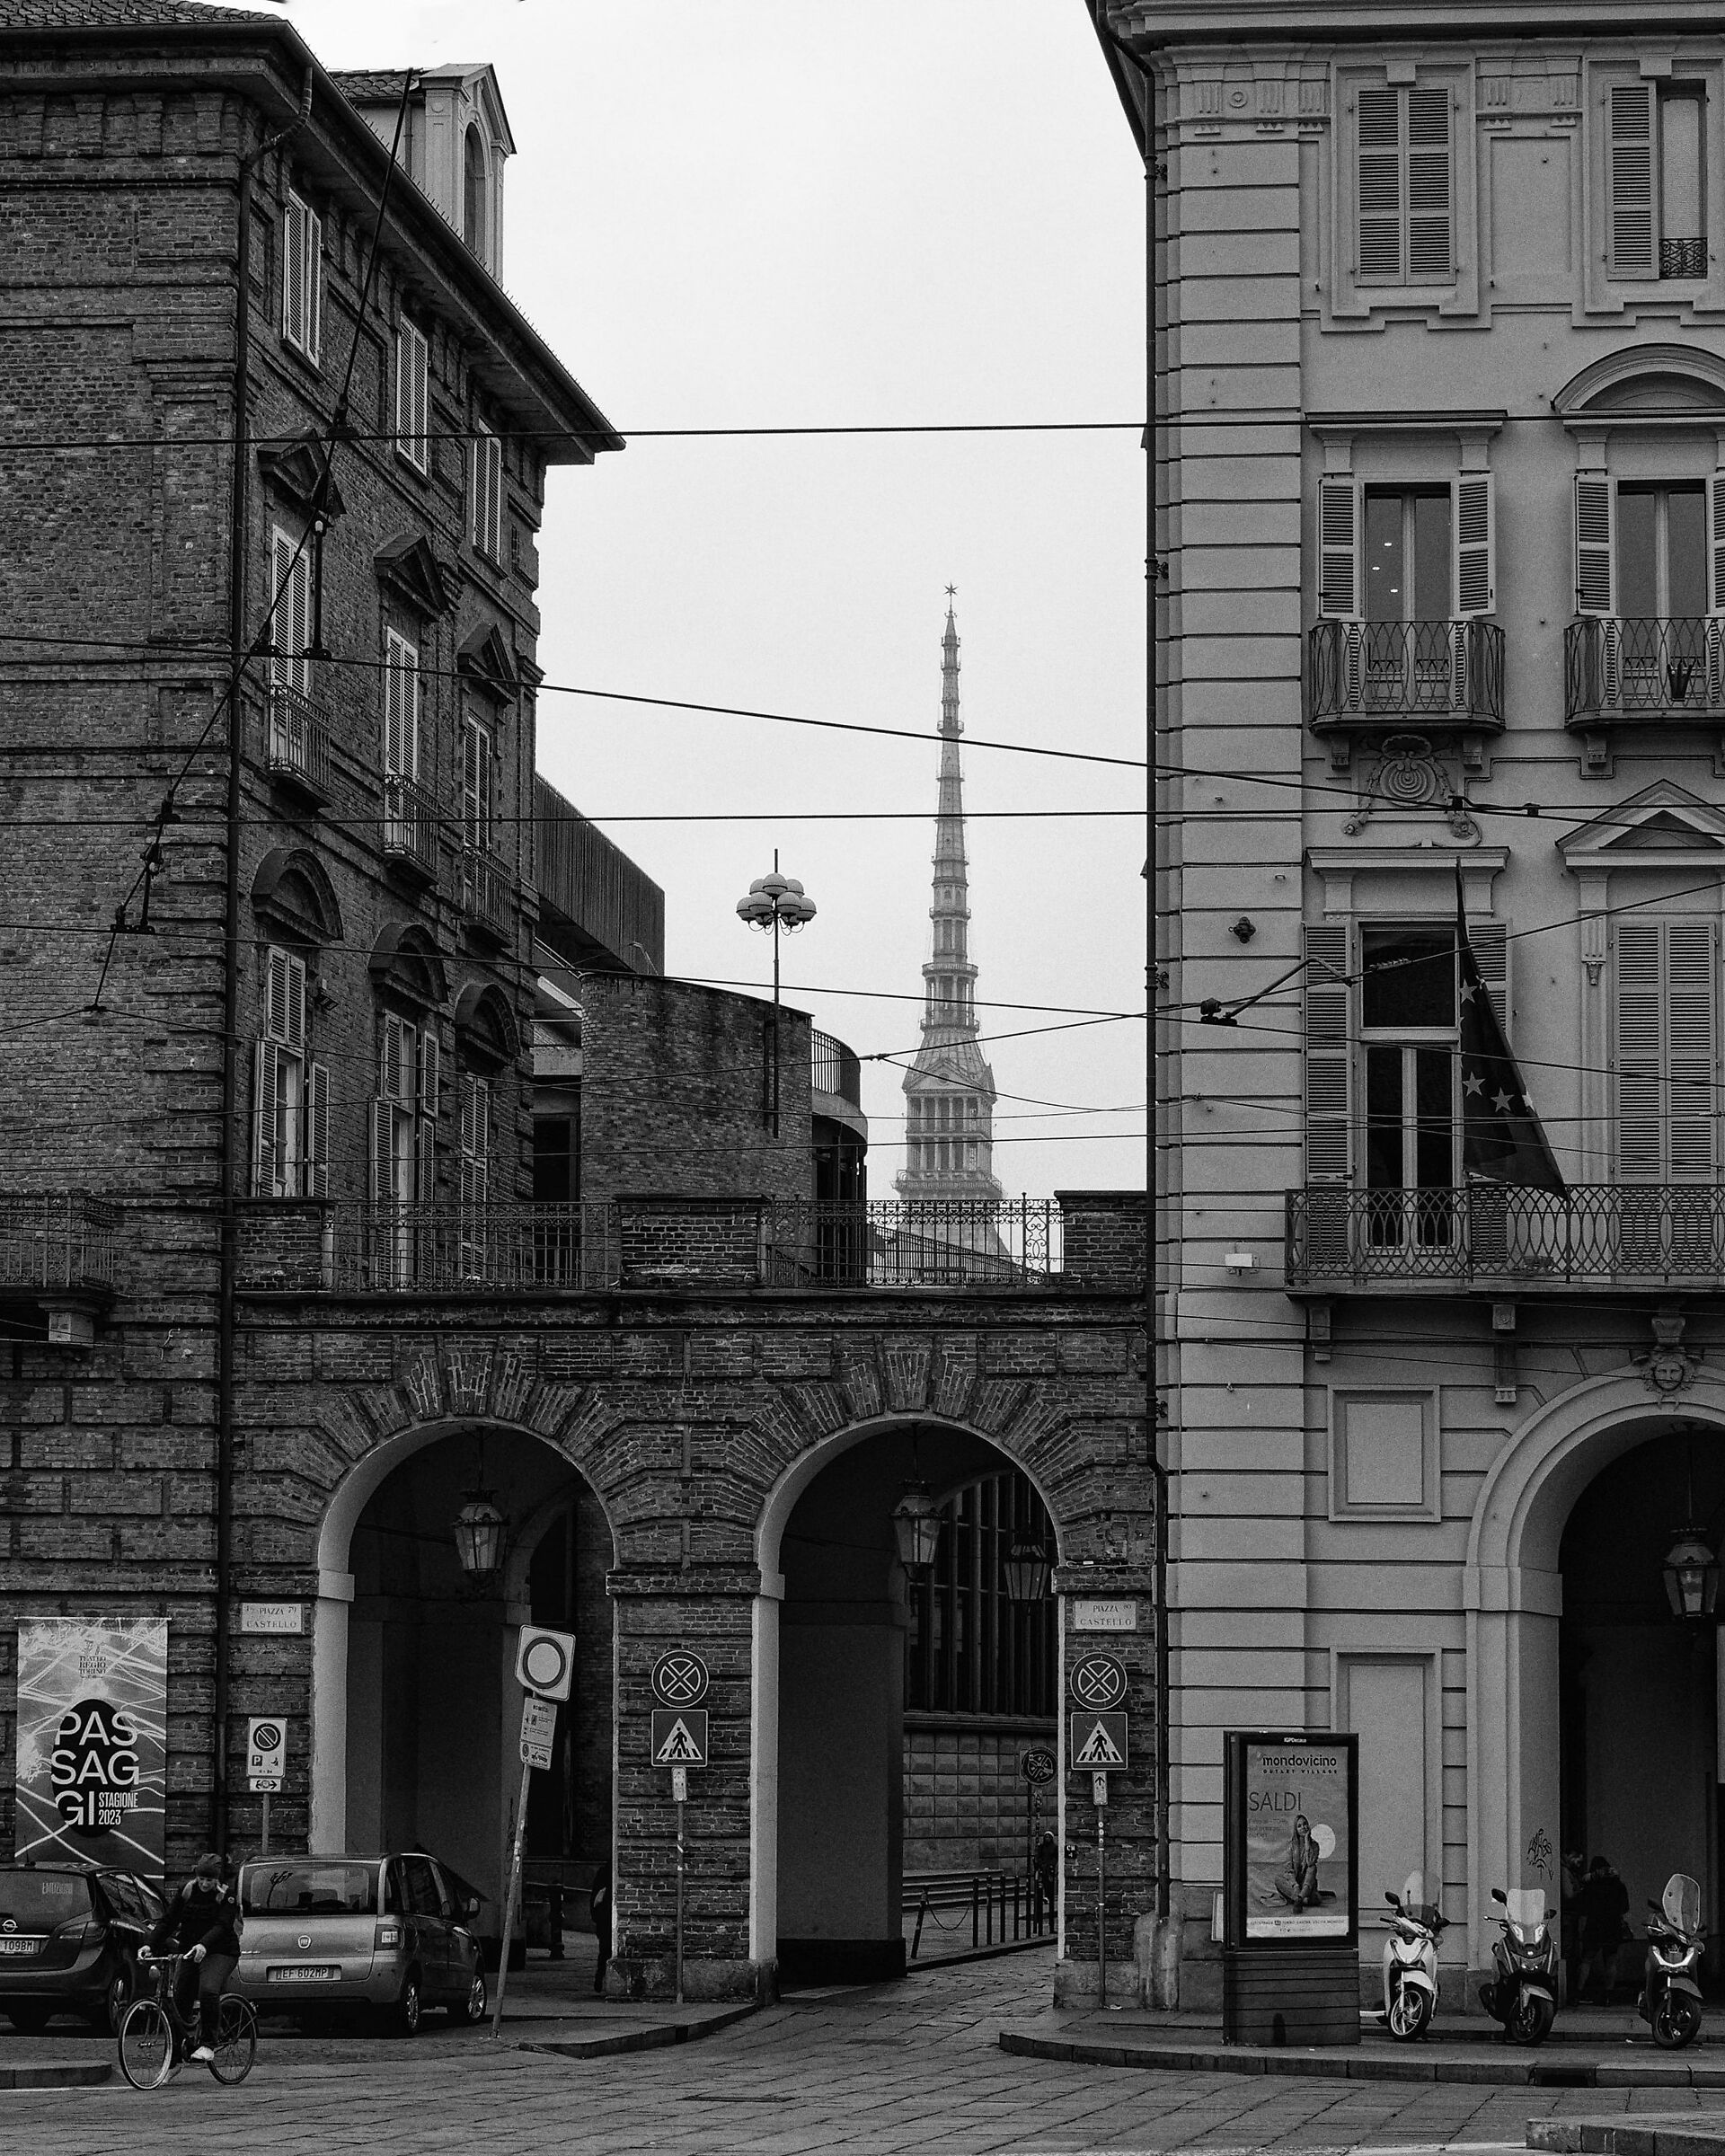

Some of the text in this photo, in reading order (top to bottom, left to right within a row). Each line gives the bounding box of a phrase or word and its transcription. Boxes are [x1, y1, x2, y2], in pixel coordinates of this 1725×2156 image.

[258, 1607, 284, 1615] PIAZZA
[1092, 1604, 1119, 1613] PIAZZA
[246, 1620, 296, 1628] CASTELLO
[1080, 1618, 1132, 1626] CASTELLO
[55, 1710, 138, 1746] PAS
[253, 1756, 261, 1765] P
[1262, 1754, 1337, 1767] mondovicino
[50, 1749, 140, 1786] SAG
[98, 1792, 138, 1808] STAGIONE
[1248, 1791, 1302, 1812] SALDI
[55, 1790, 95, 1825] GI
[98, 1808, 121, 1825] 2023
[282, 1967, 328, 1979] EF 602MP
